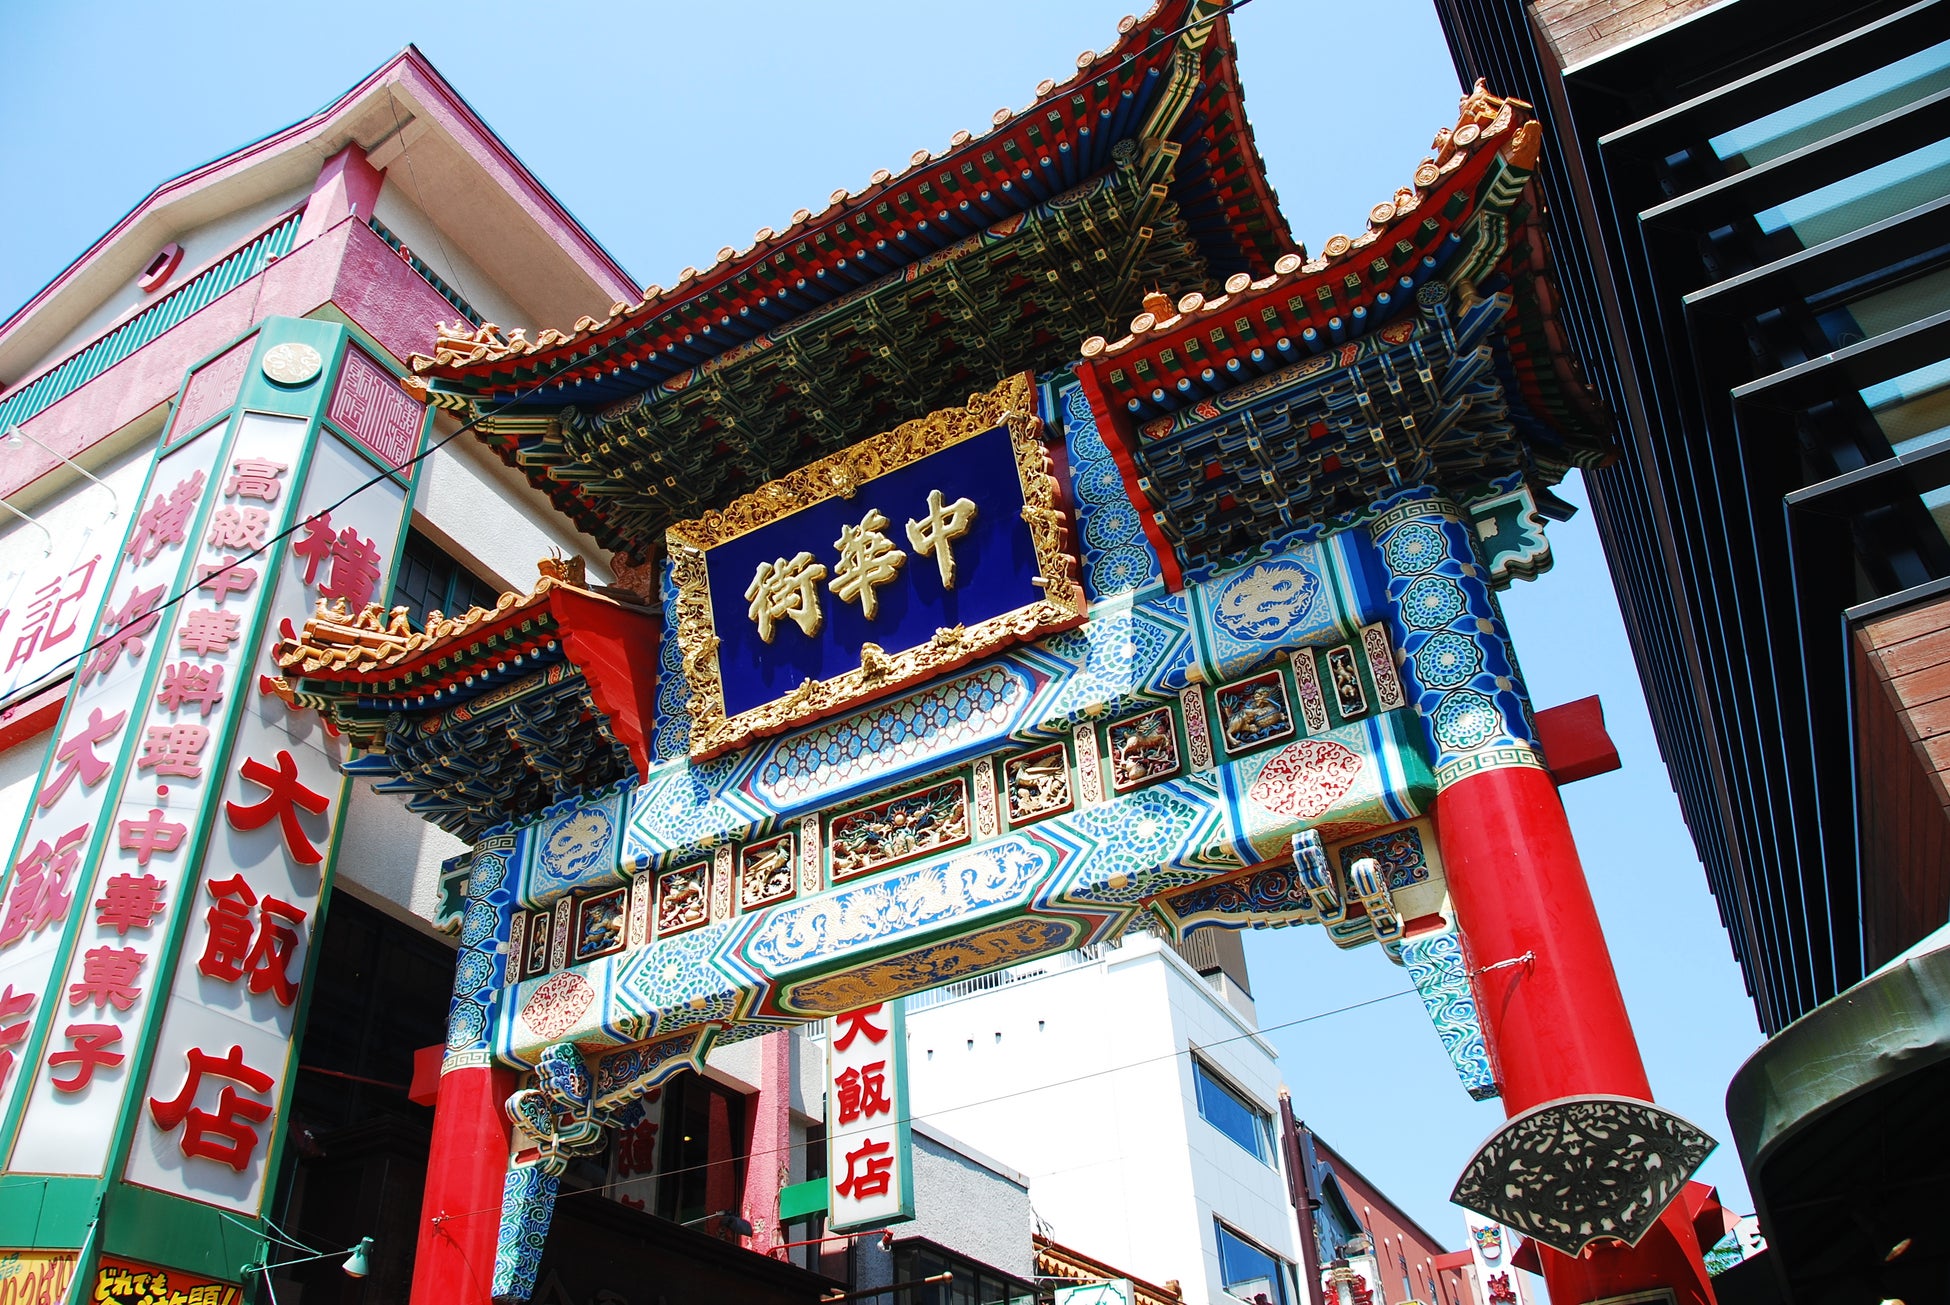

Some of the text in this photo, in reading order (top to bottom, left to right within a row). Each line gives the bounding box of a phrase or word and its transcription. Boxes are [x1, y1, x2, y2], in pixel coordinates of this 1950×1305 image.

[0, 554, 102, 674] 記
[744, 489, 978, 643] 中華街
[48, 457, 288, 1092] 高級中華料理・中華菓子
[834, 1003, 894, 1200] 大飯店
[95, 1268, 168, 1299] どれでも
